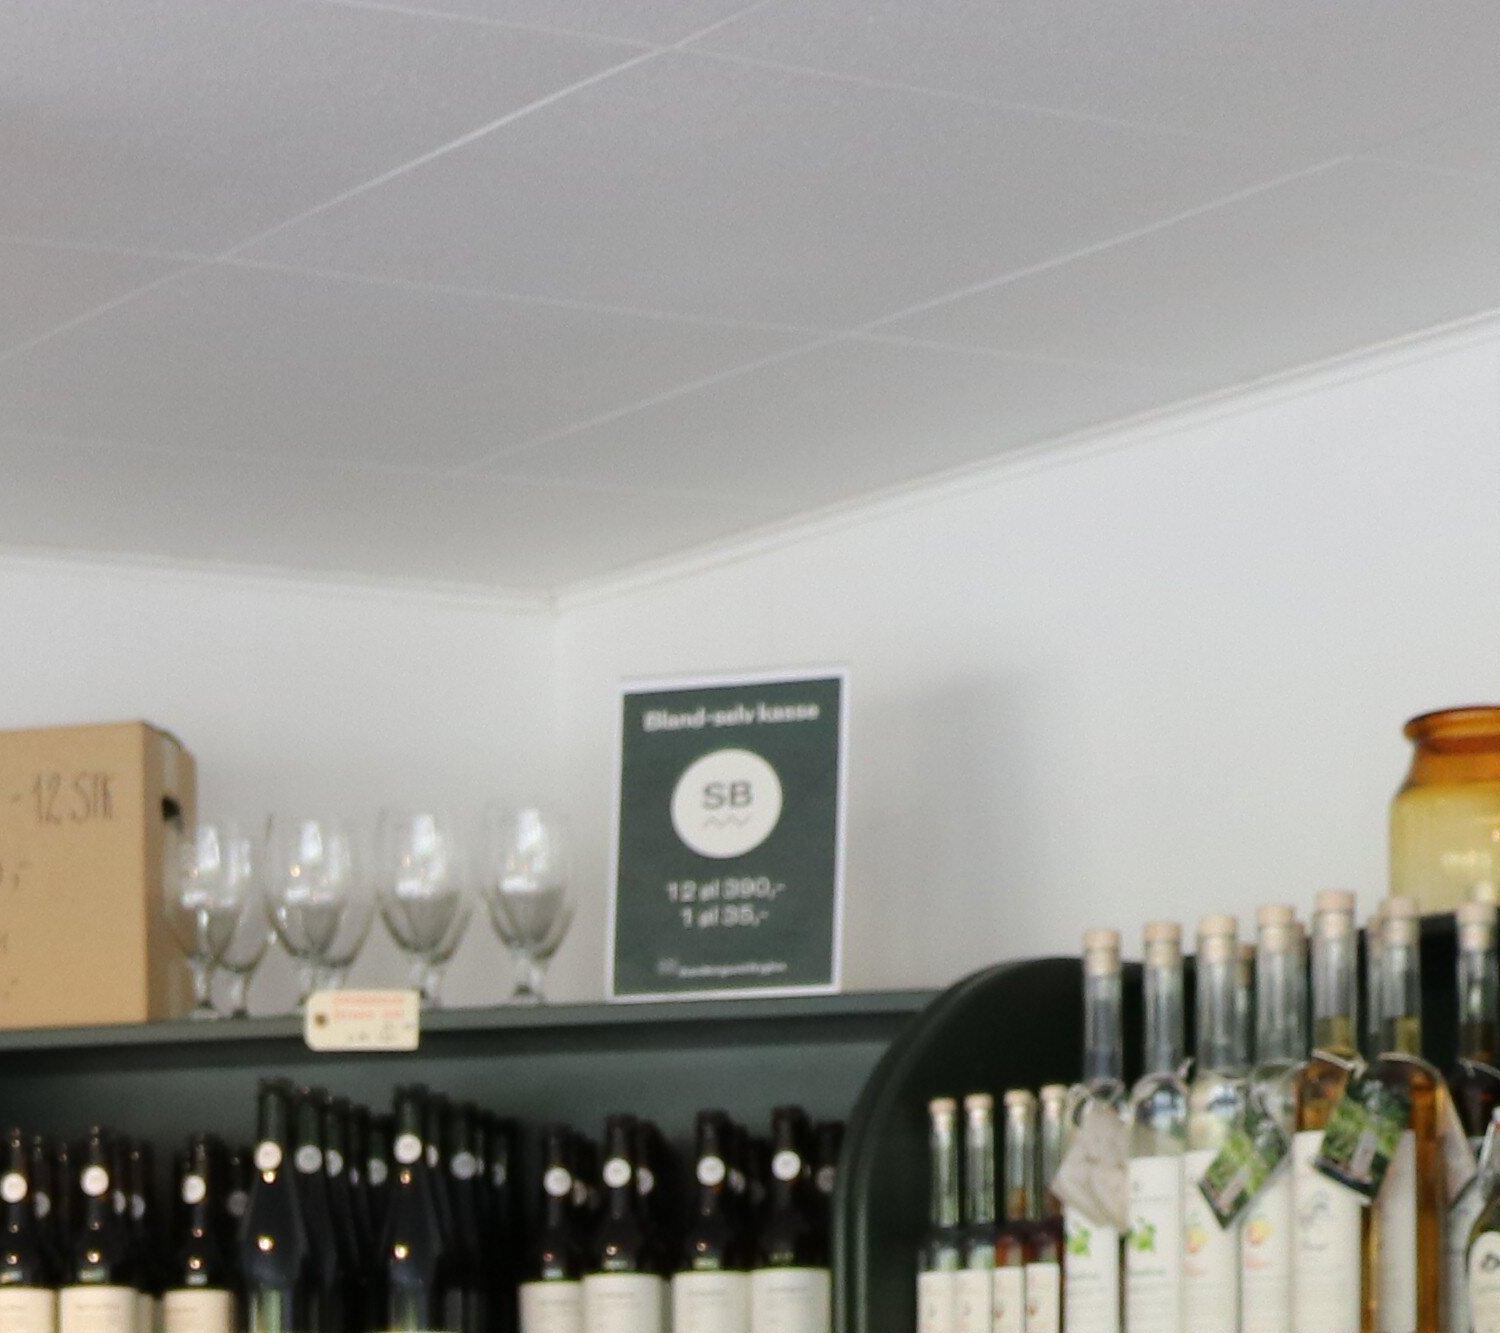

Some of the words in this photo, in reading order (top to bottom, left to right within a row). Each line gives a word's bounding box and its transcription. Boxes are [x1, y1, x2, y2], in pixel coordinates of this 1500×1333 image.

[704, 782, 751, 810] SB
[666, 879, 697, 902] 12
[681, 906, 693, 928] 1
